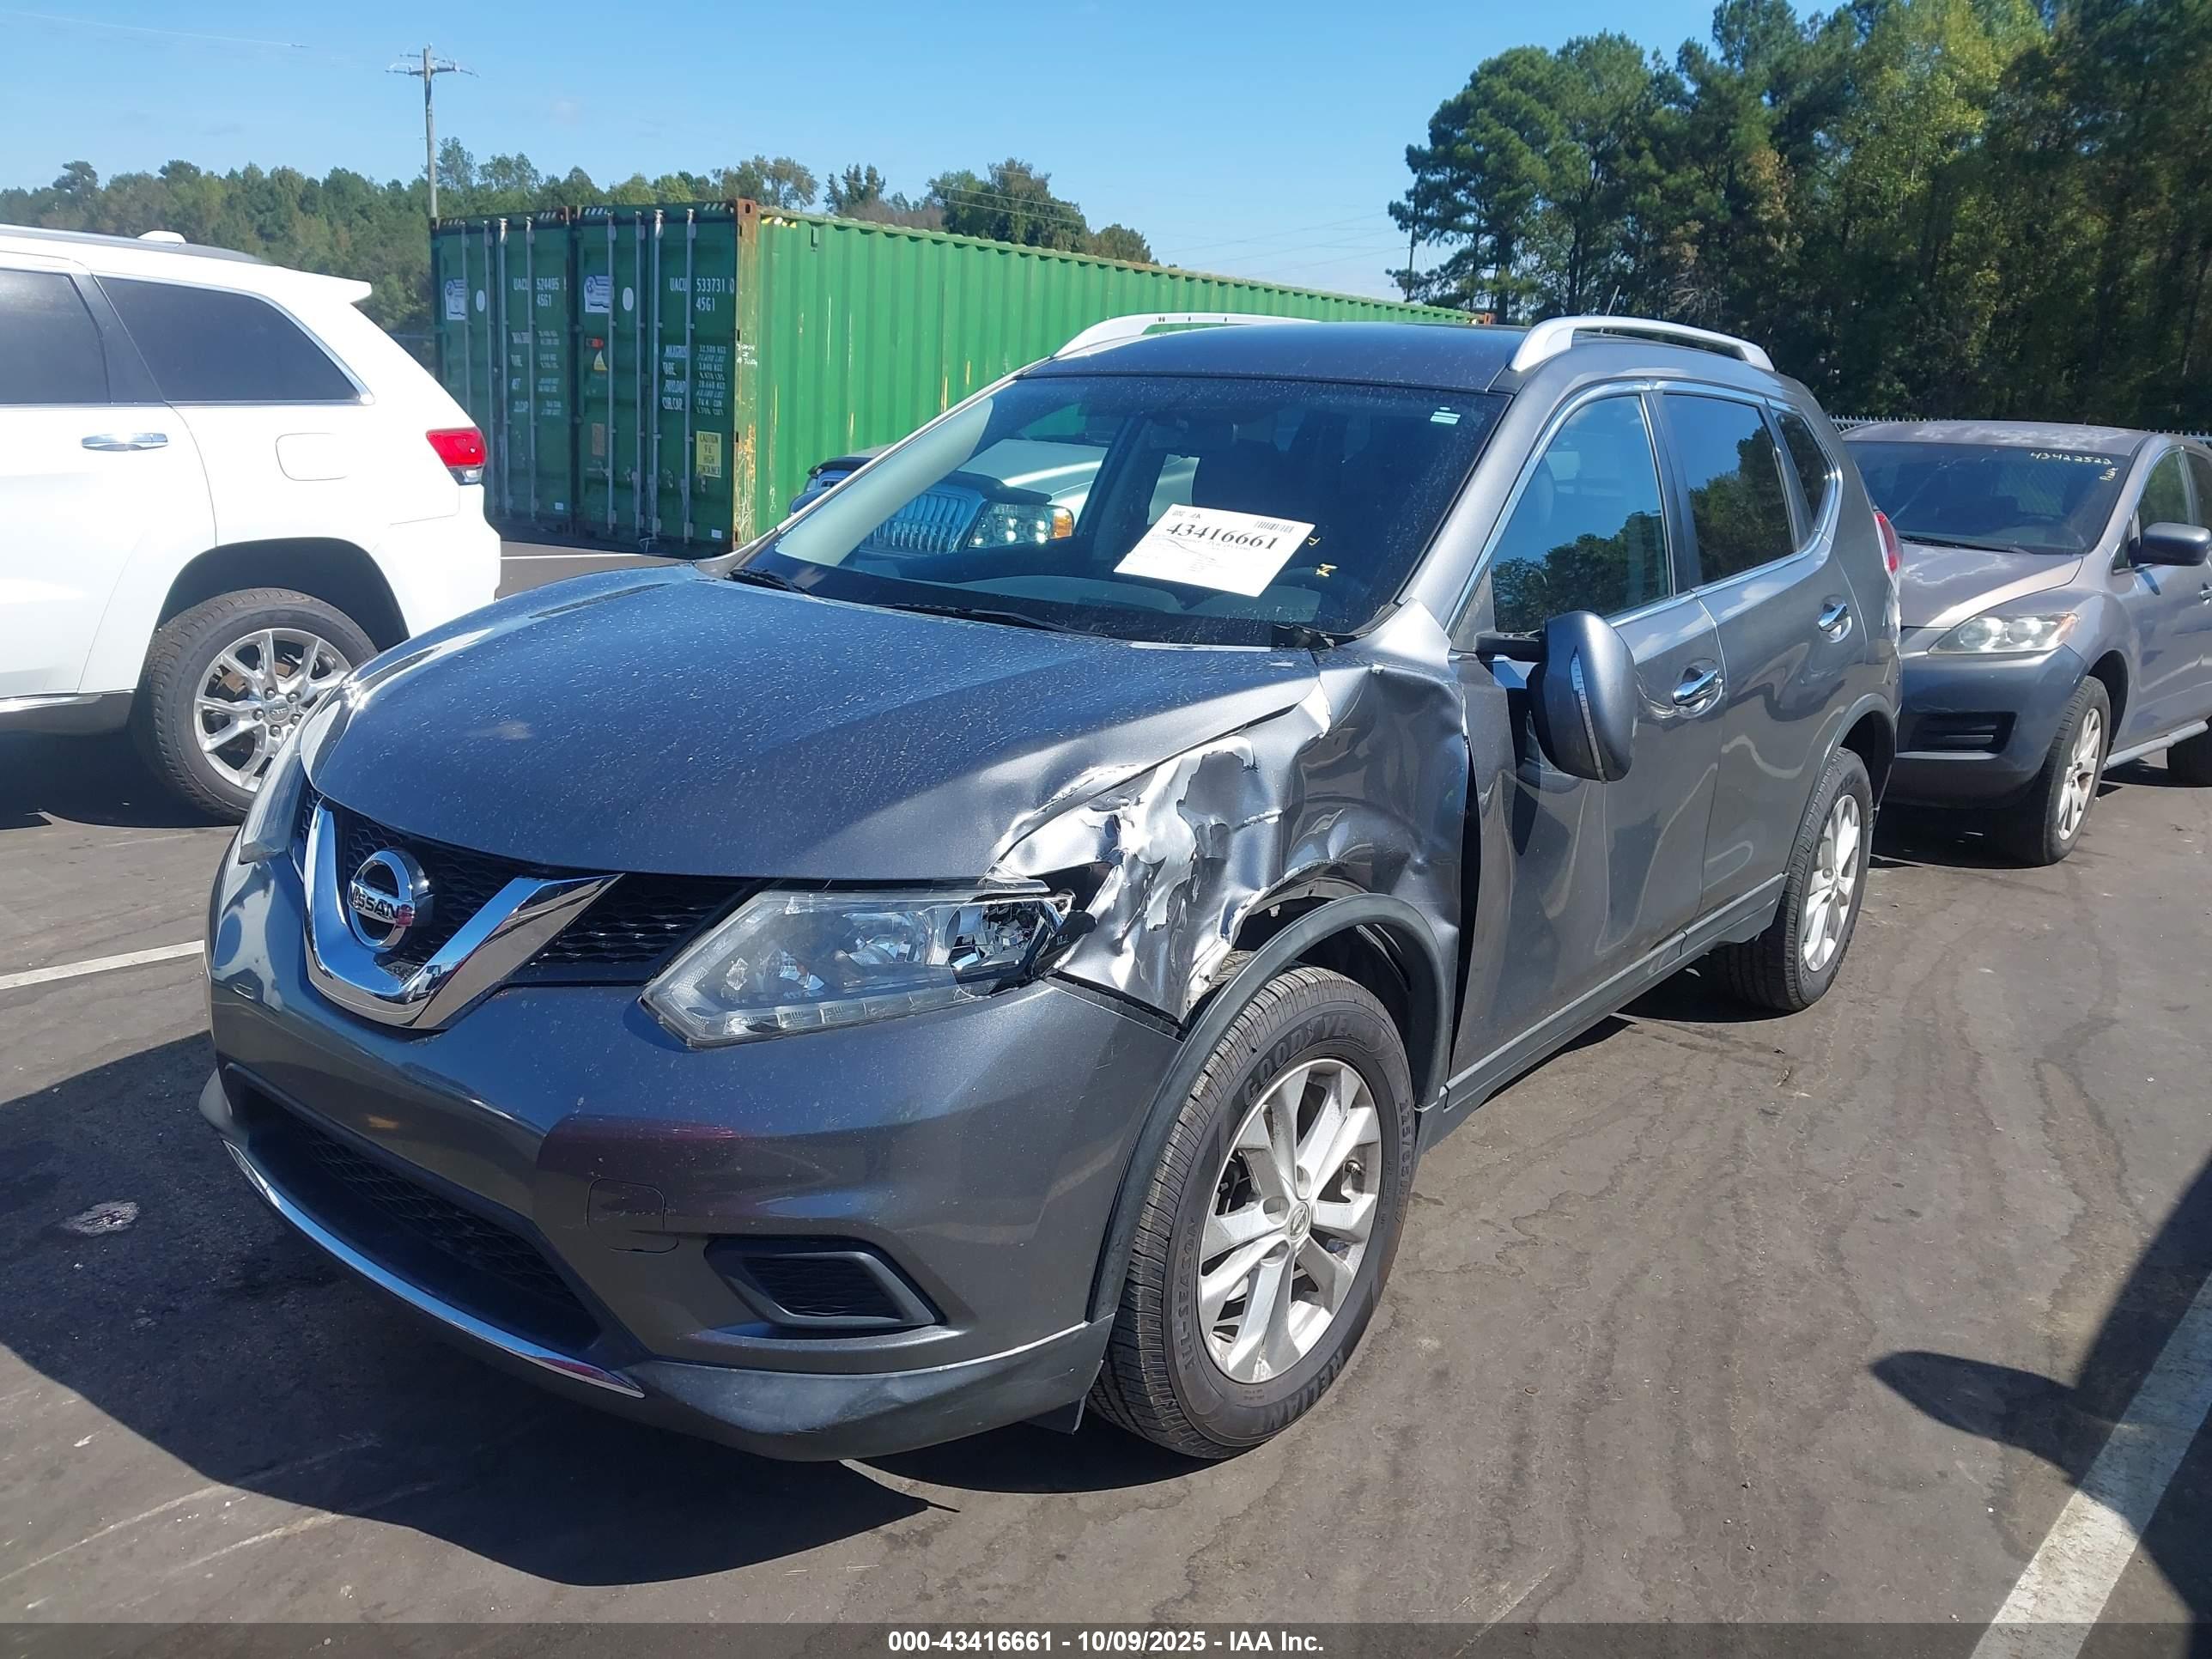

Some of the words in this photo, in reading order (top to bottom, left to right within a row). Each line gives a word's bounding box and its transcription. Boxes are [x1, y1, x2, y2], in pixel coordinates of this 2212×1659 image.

[696, 277, 725, 293] 533731
[696, 297, 715, 312] 45G1
[1166, 522, 1279, 550] 43416661
[349, 883, 400, 919] NISSAN
[1177, 1215, 1196, 1372] ALL-SEASON
